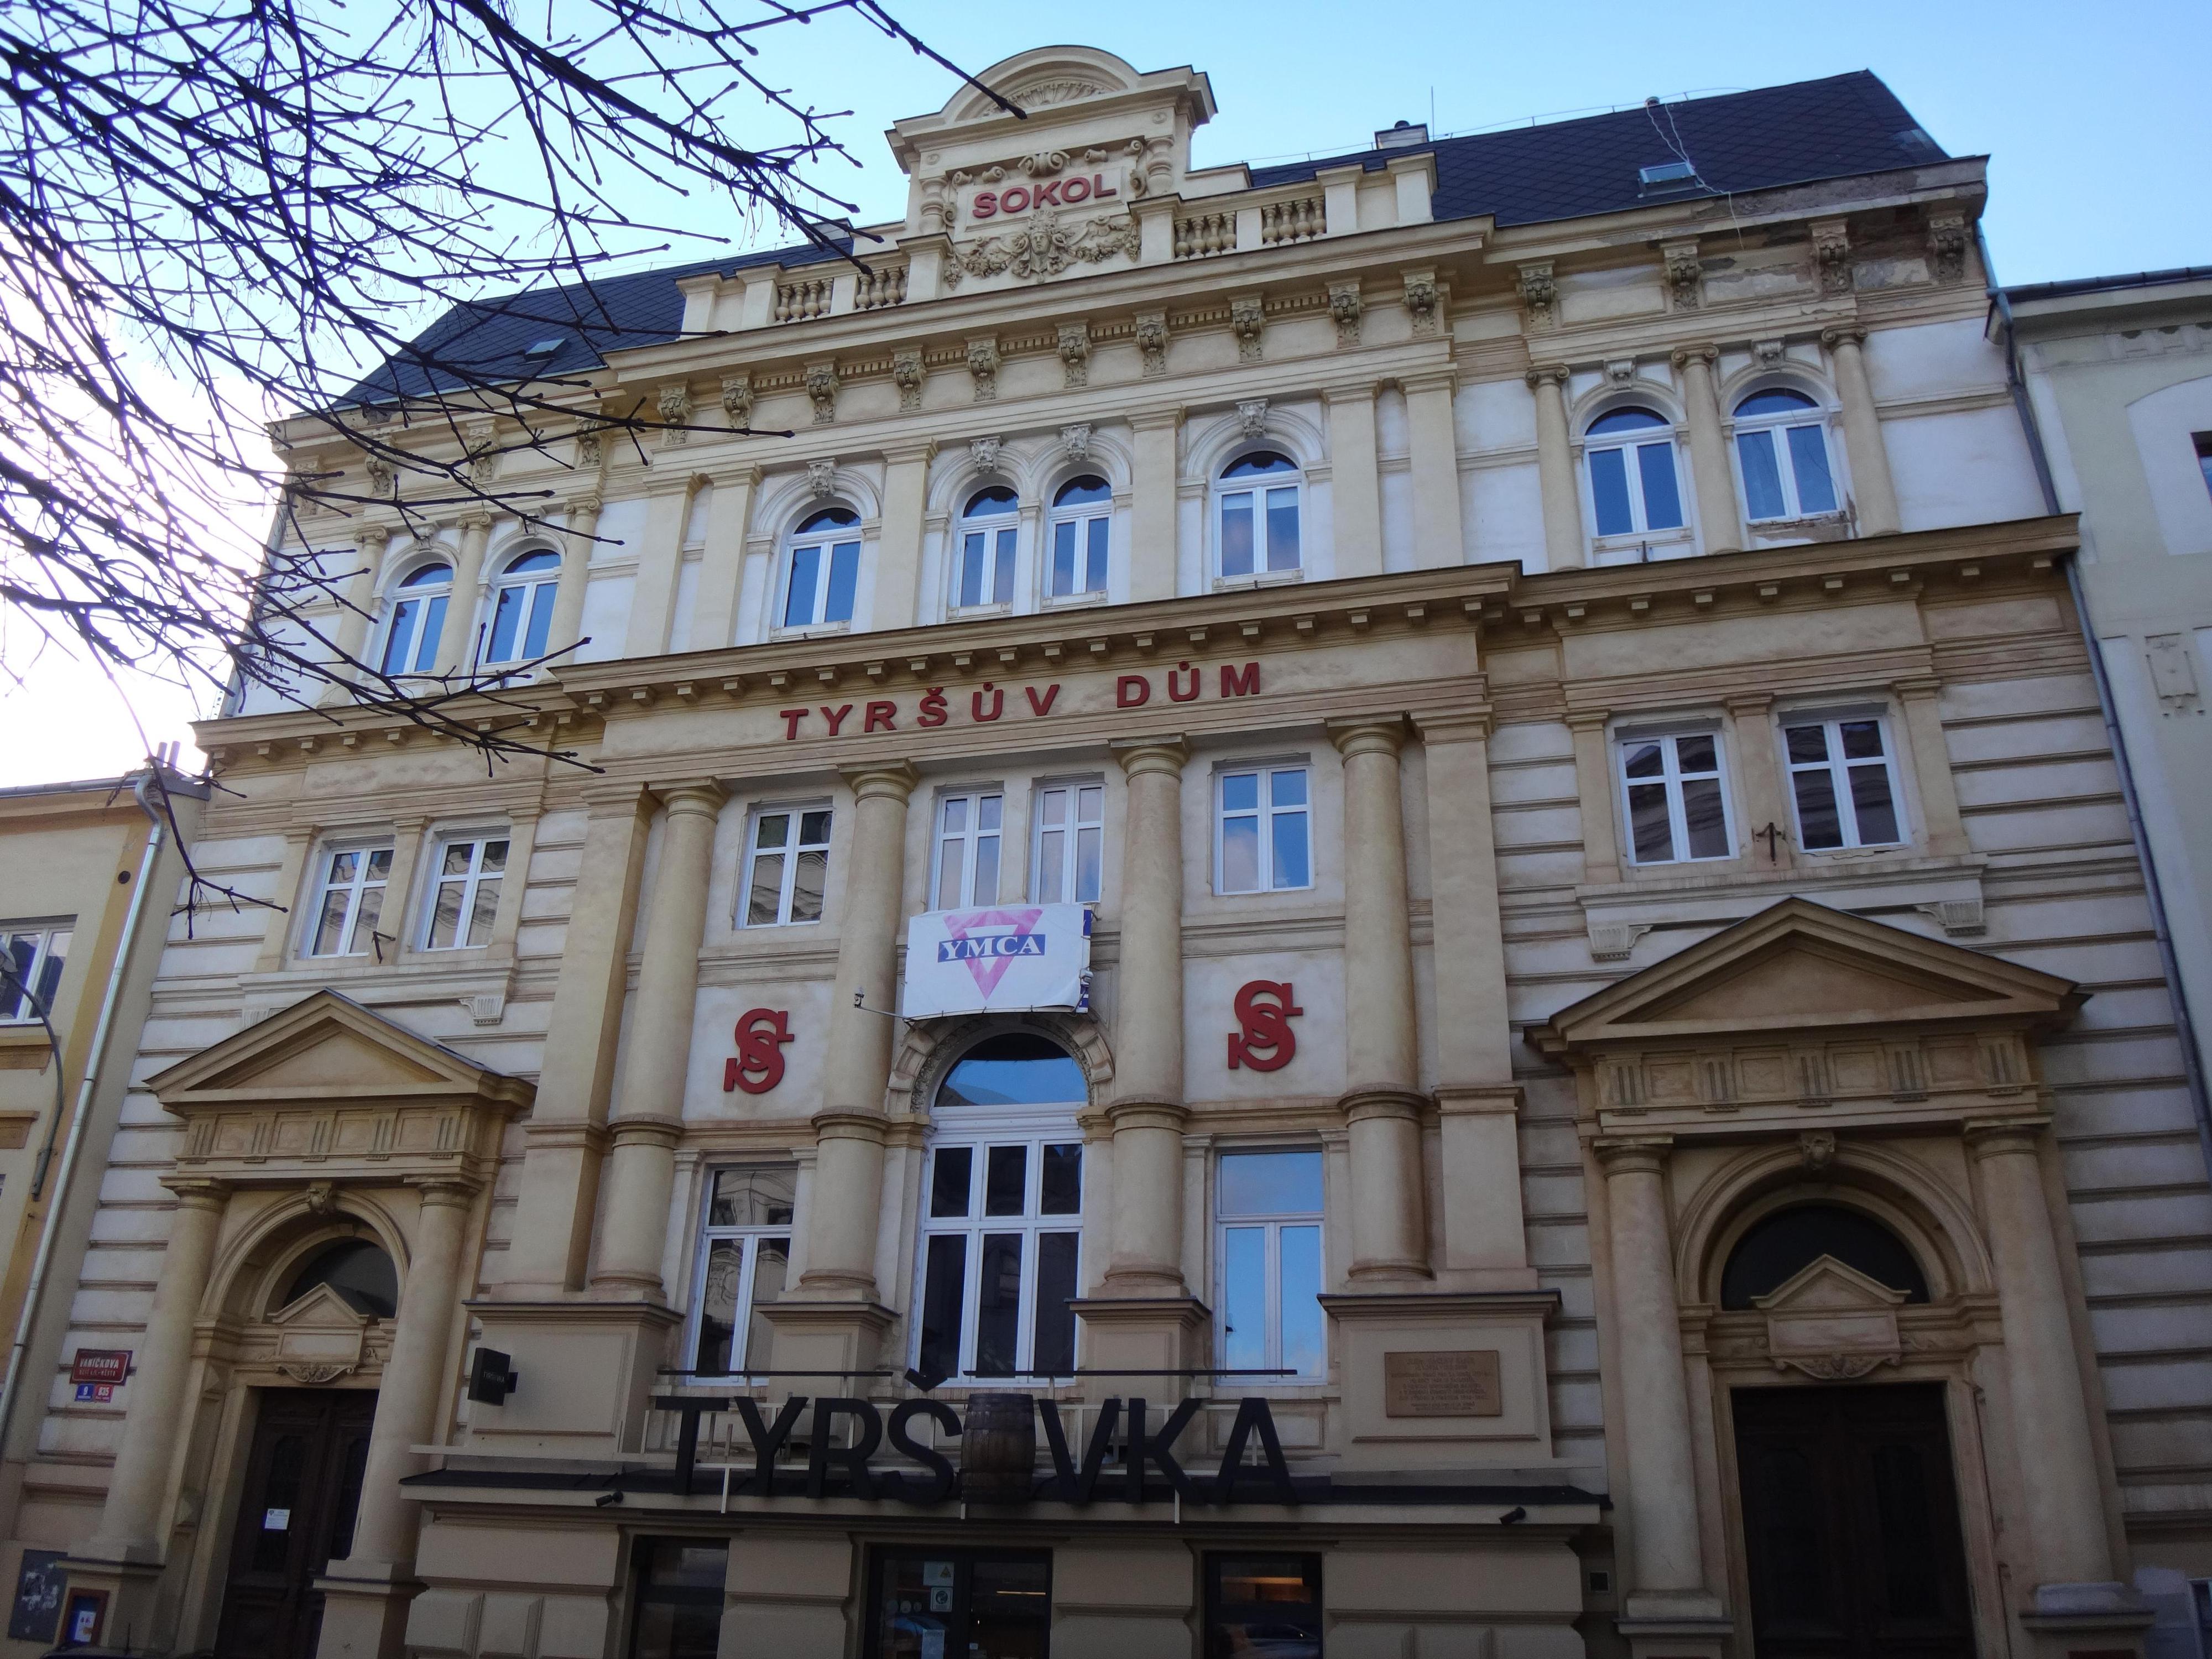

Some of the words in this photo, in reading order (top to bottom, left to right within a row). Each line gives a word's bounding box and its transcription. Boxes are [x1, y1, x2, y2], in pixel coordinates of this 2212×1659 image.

[972, 174, 1117, 218] SOKOL
[780, 681, 1060, 740] TYRŠŮV
[1117, 660, 1260, 708] DŮM
[941, 936, 1041, 960] YMCA
